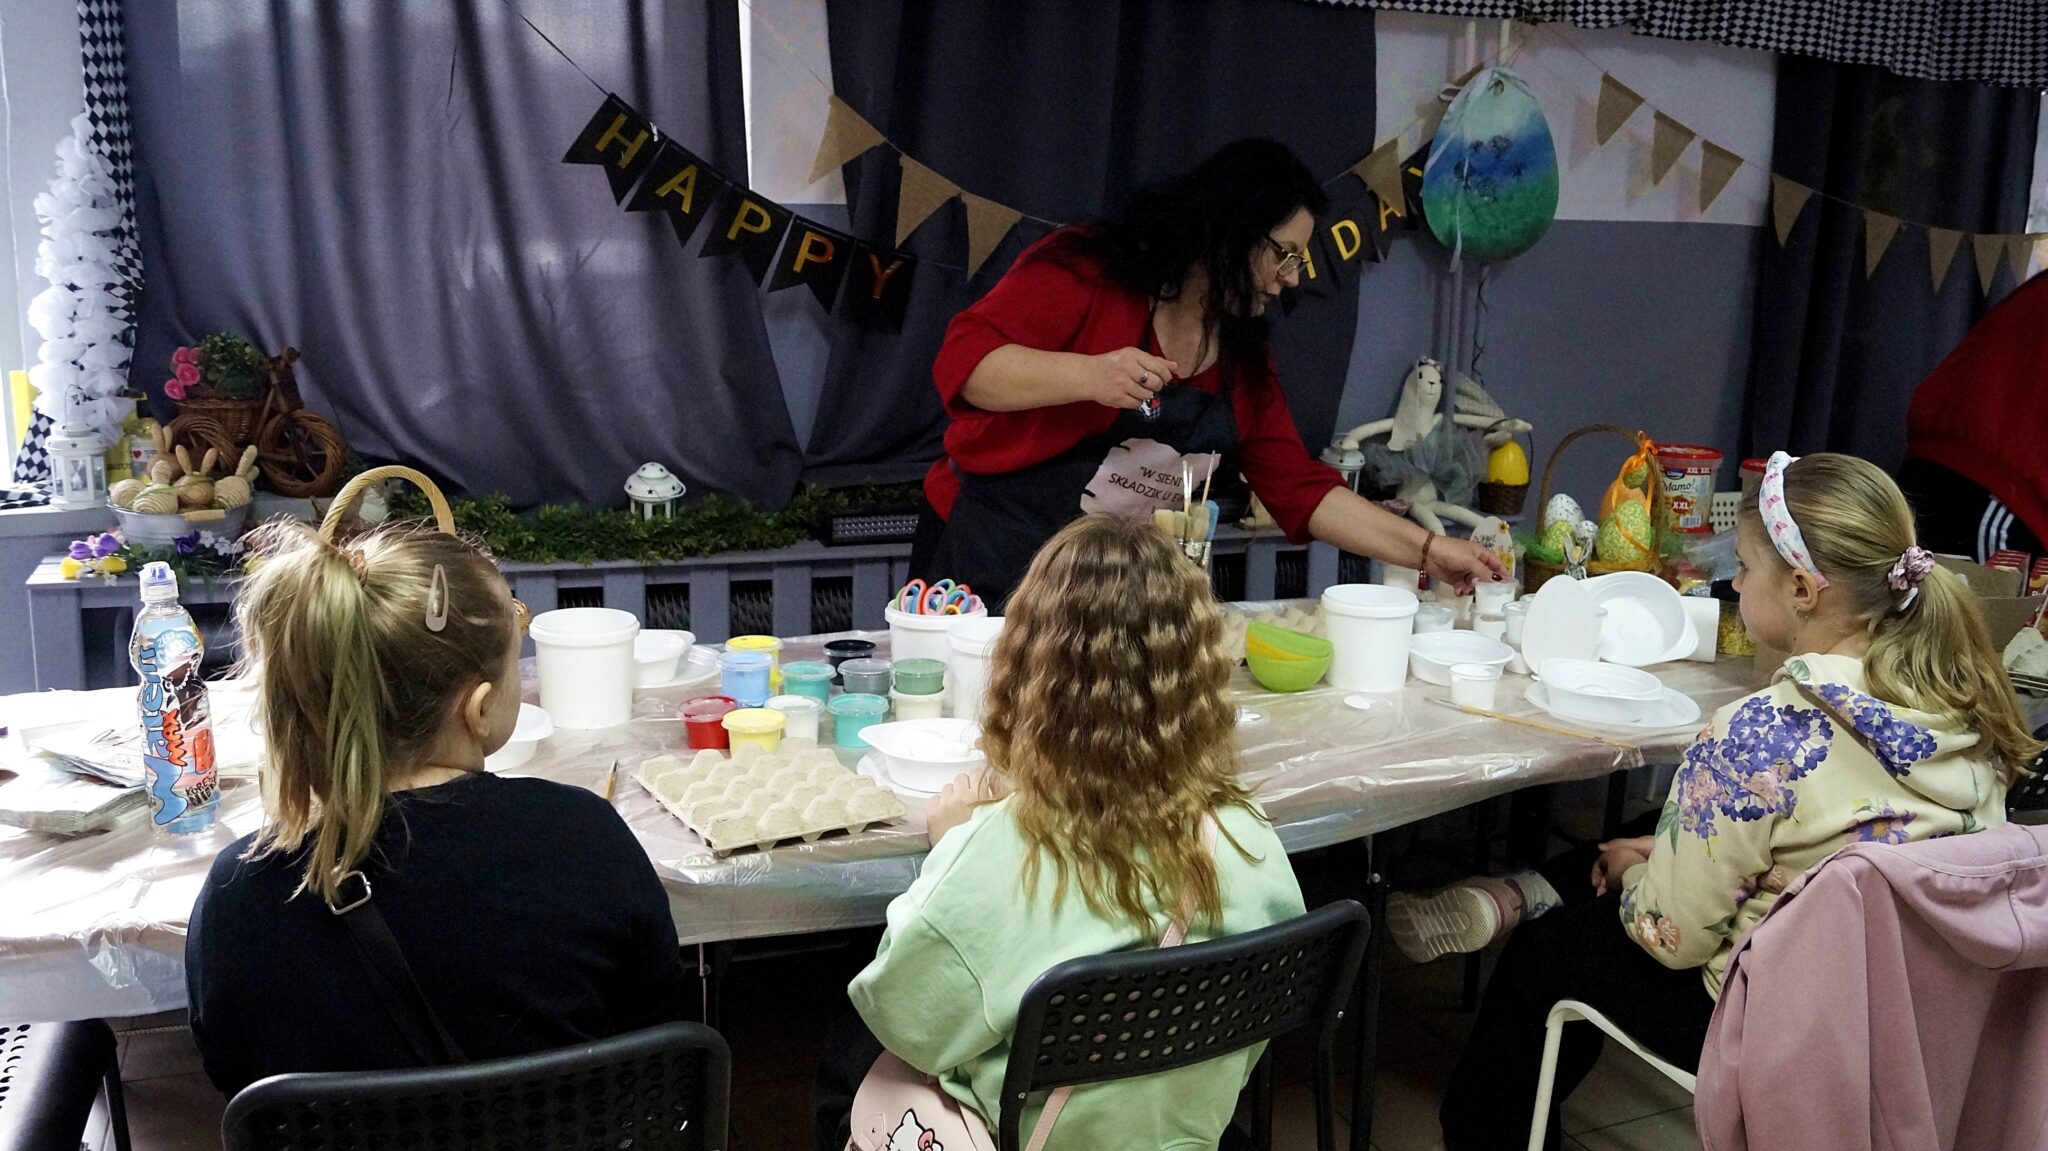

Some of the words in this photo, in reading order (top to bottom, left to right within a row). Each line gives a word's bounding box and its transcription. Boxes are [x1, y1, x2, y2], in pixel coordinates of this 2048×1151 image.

[595, 112, 903, 299] HAPPY
[1108, 473, 1163, 499] SKŁADZIK
[1673, 502, 1689, 510] XXL
